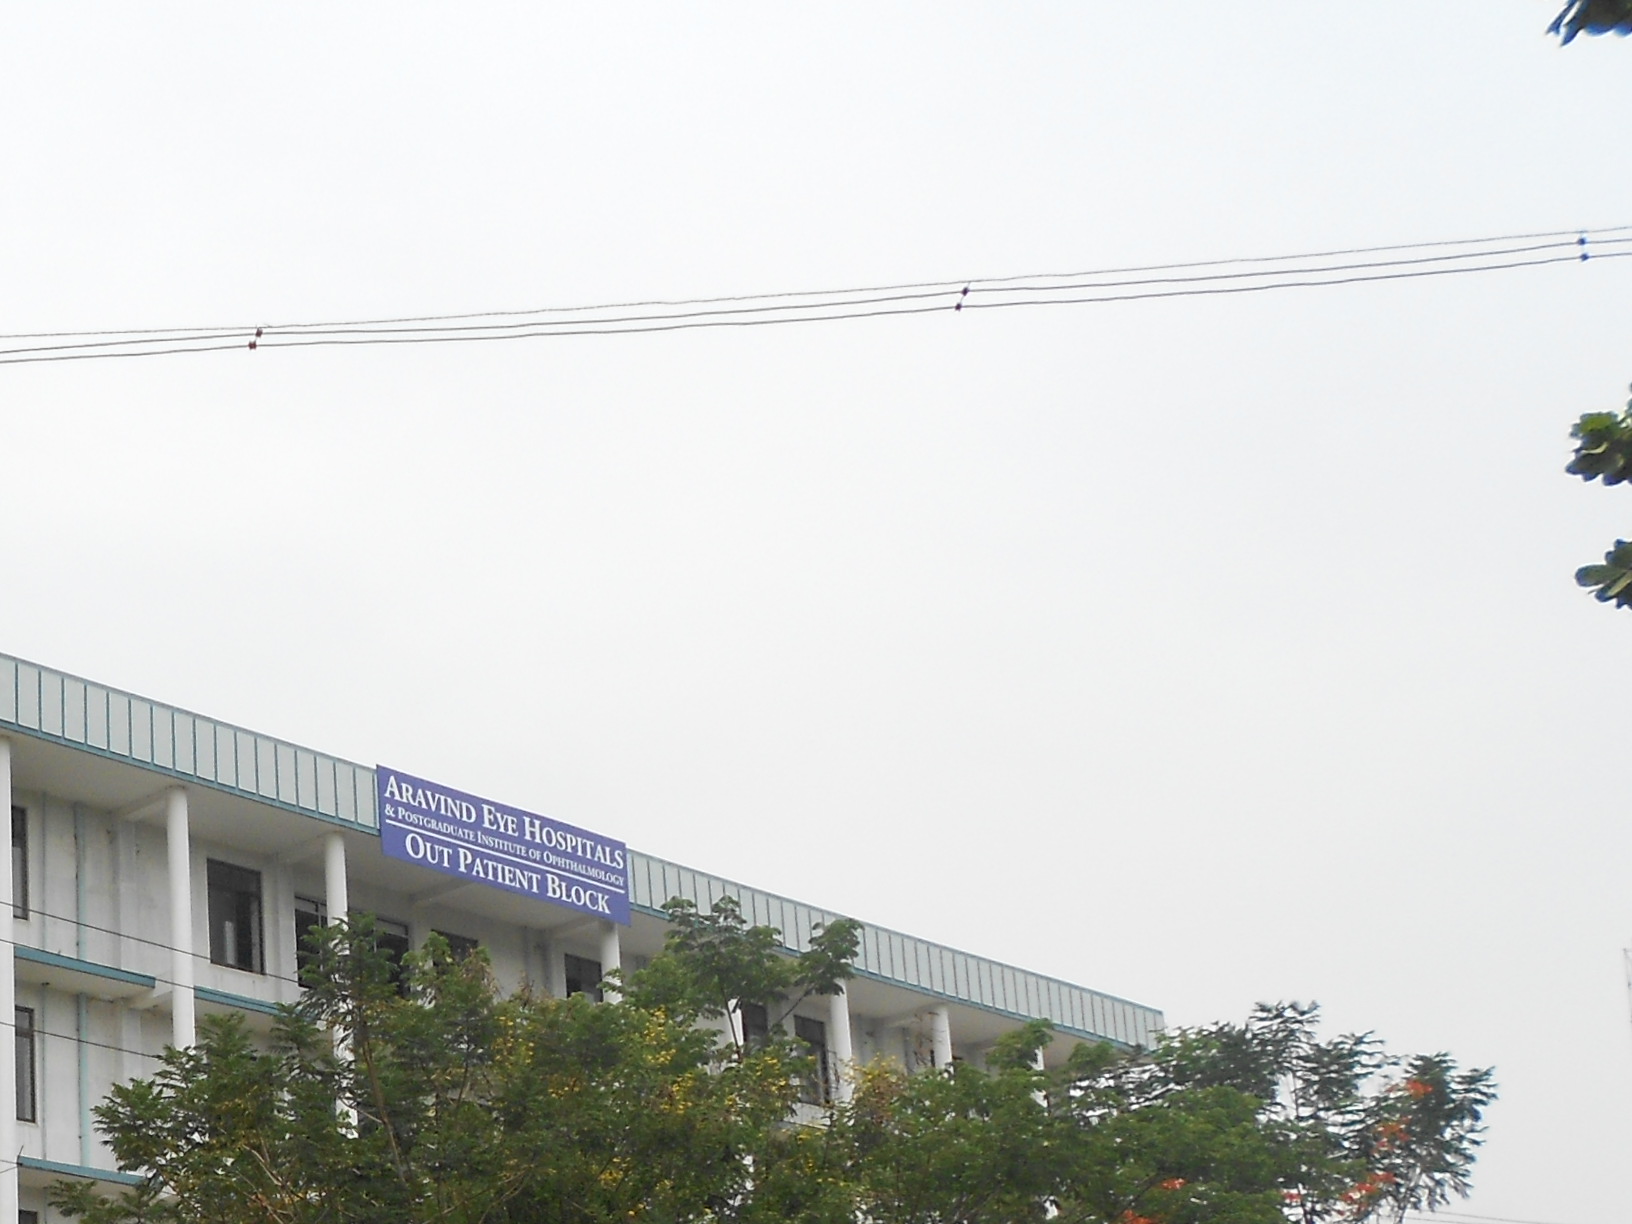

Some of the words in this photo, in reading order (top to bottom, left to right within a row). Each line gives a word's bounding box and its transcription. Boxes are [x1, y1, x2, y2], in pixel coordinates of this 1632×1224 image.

[384, 775, 477, 824] ARAVIND
[481, 804, 519, 837] EYE
[523, 816, 625, 870] HOSPITALS
[384, 803, 396, 818] &
[398, 808, 475, 842] POSTGRADUATE
[477, 831, 528, 857] INSTITUTE
[529, 848, 542, 861] OF
[543, 850, 625, 888] OPHTHALMOLOGY
[405, 833, 453, 868] OUT
[458, 847, 541, 894] PATIENT
[546, 873, 611, 915] BLOCK
